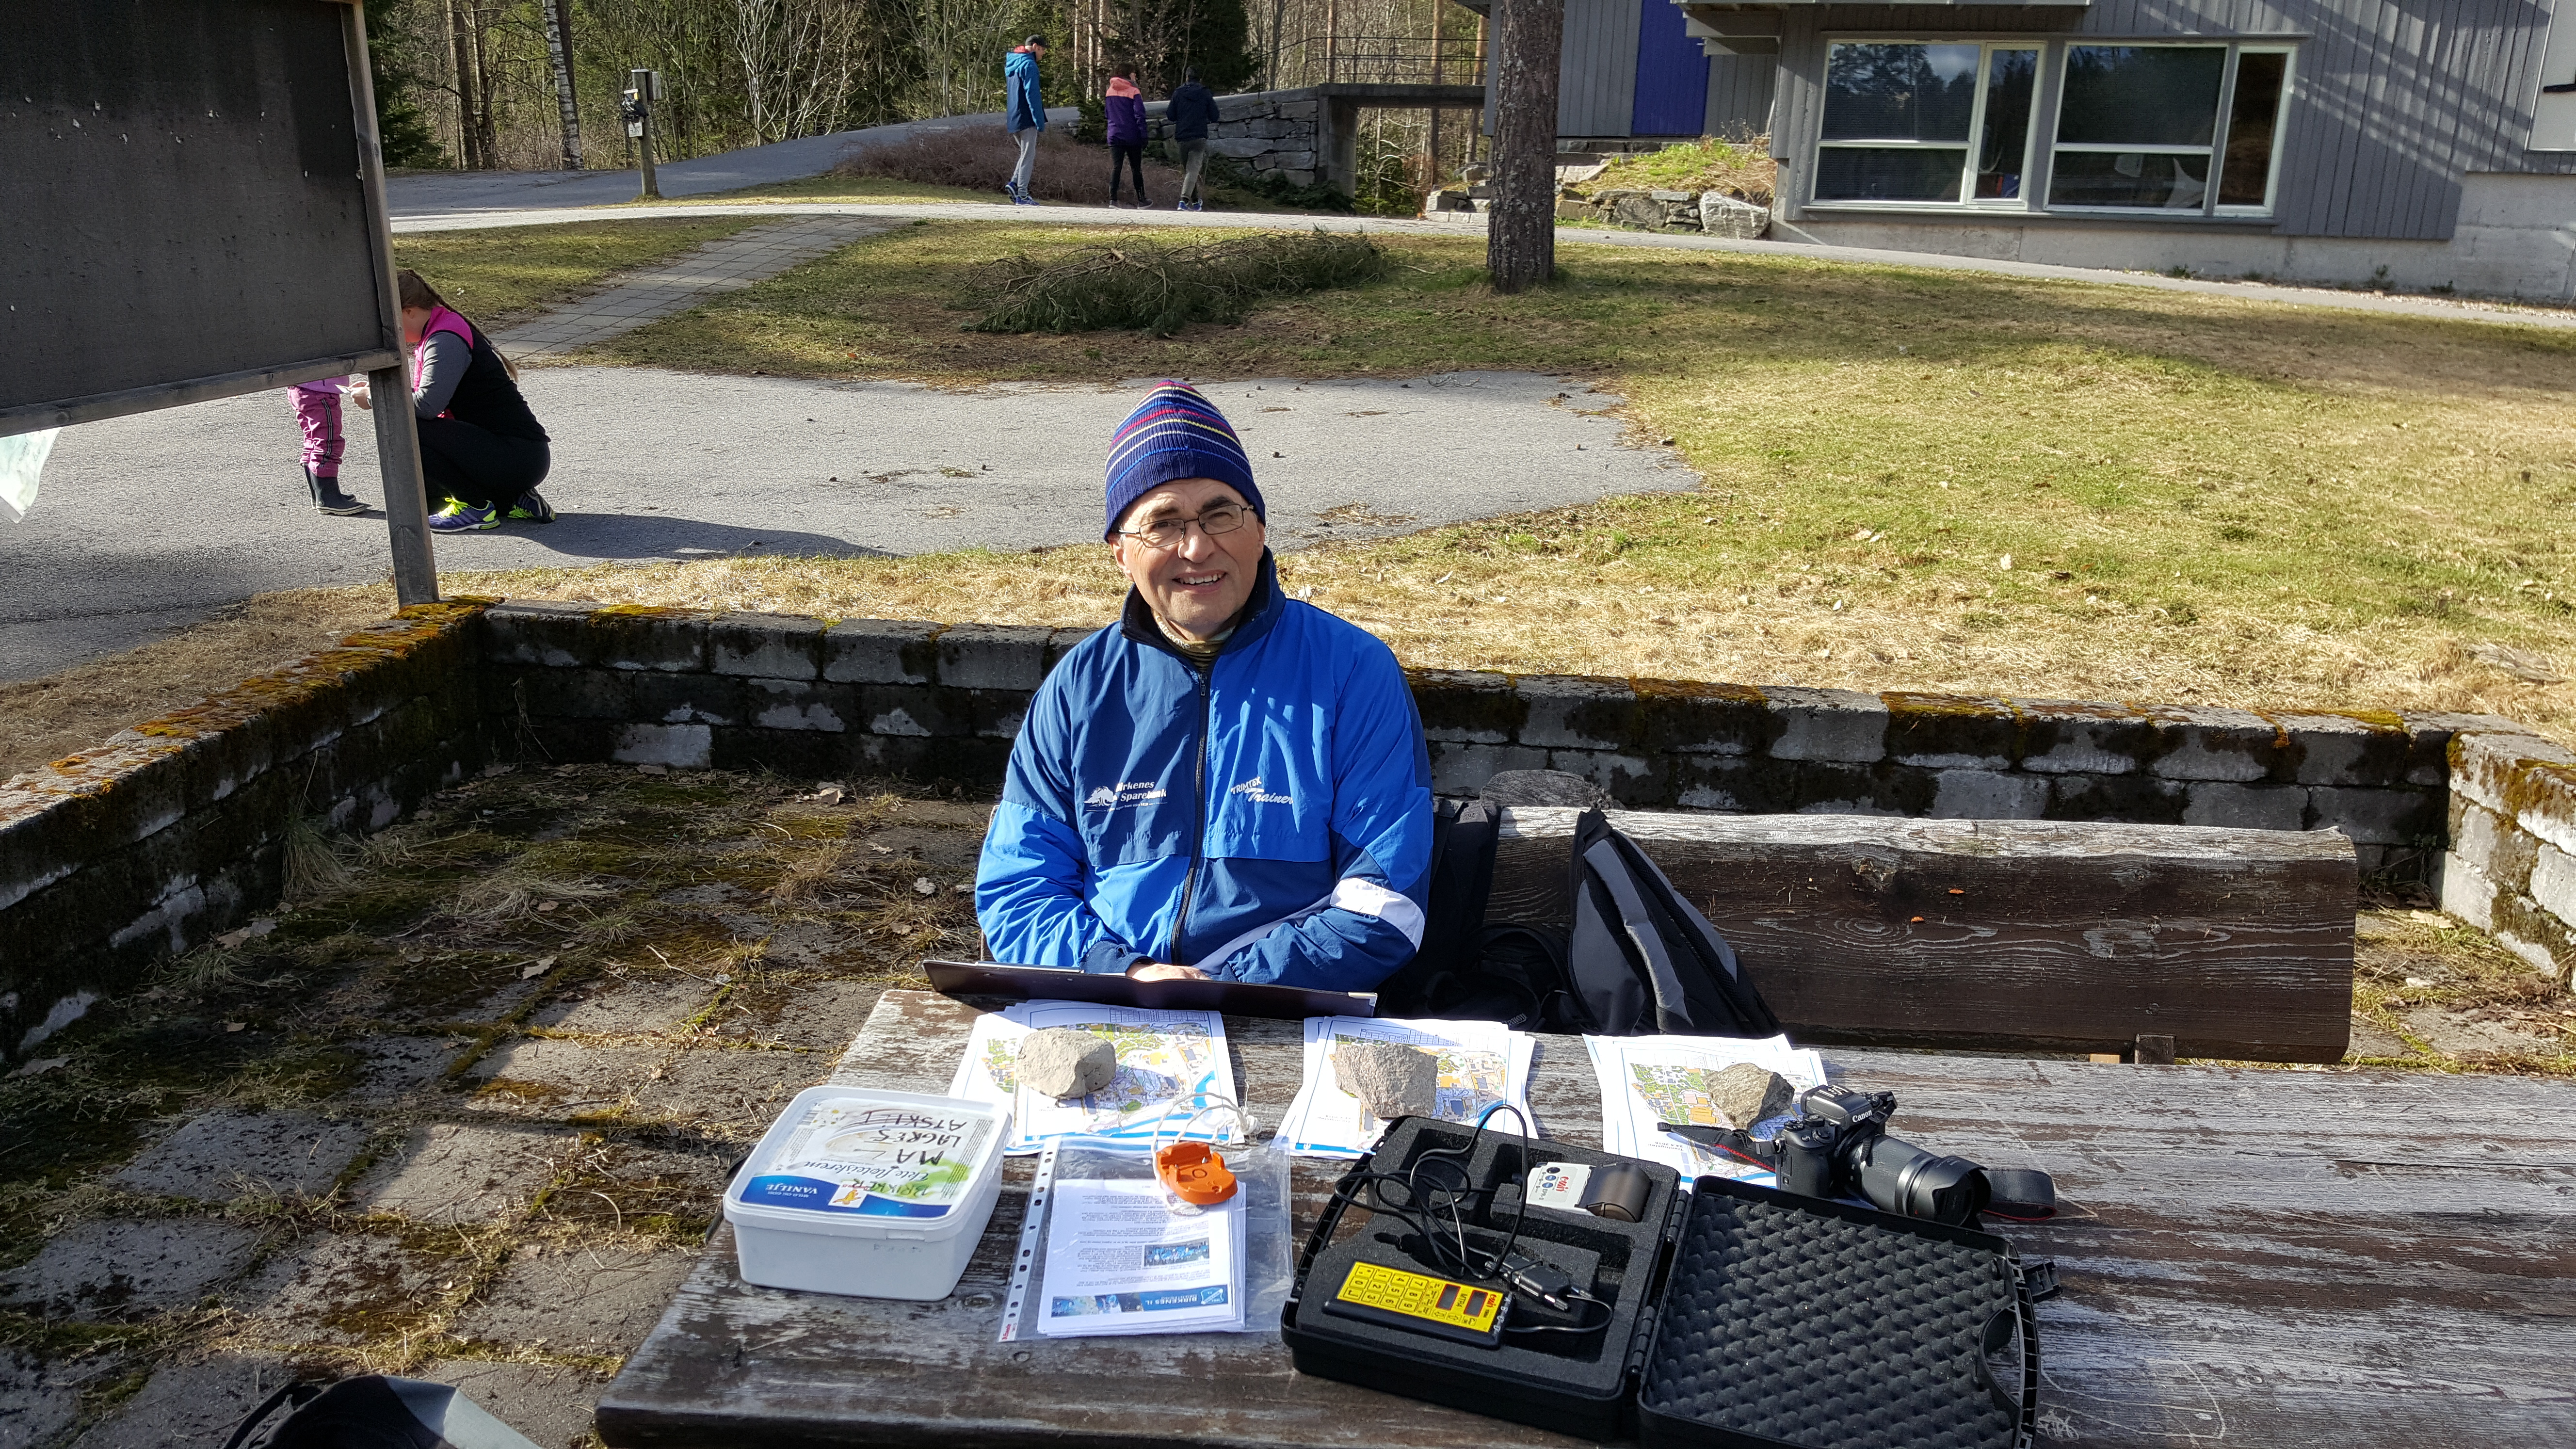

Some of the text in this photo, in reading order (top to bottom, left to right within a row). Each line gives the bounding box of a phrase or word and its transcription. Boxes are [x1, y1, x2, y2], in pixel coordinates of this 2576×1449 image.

[1230, 776, 1262, 795] TRIMTEX
[1244, 788, 1294, 805] Trainer
[1852, 1110, 1873, 1123] Canon
[765, 1183, 818, 1194] VANILJE
[1155, 1297, 1198, 1305] BIRKENES
